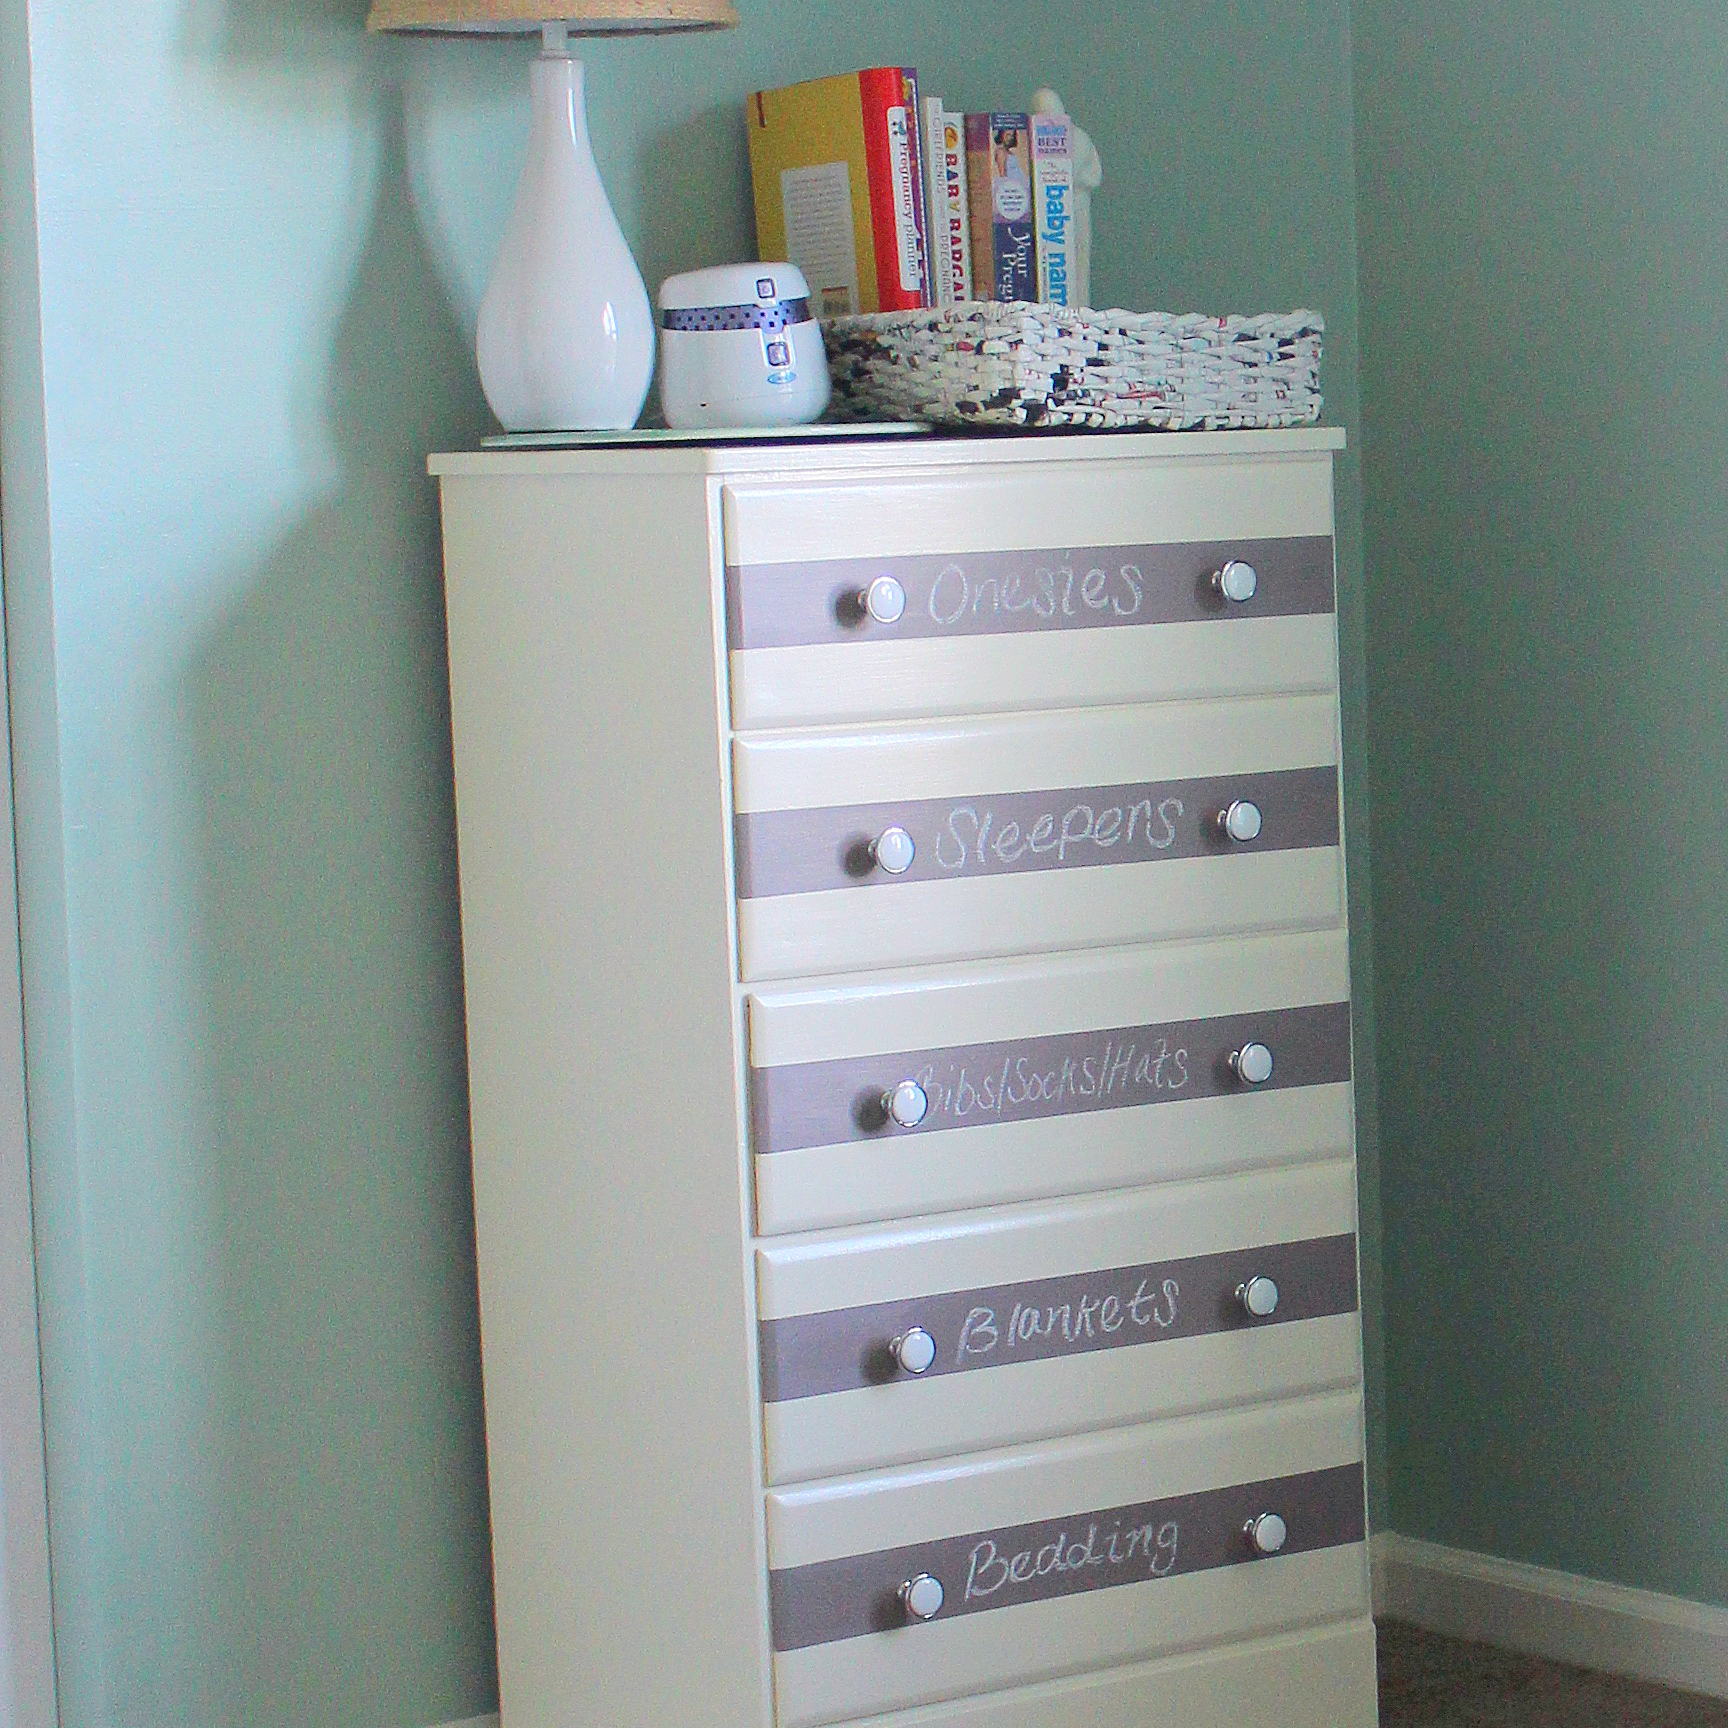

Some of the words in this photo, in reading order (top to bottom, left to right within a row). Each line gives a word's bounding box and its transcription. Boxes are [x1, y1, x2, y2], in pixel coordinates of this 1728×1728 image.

[899, 141, 913, 220] Pregnancy
[1041, 185, 1070, 245] baby
[903, 224, 917, 277] planner
[1007, 226, 1032, 278] Your
[929, 551, 1144, 624] Onesies
[936, 797, 1184, 870] Sleepers
[956, 1278, 1180, 1366] Blankets
[964, 1521, 1180, 1603] Bedding
